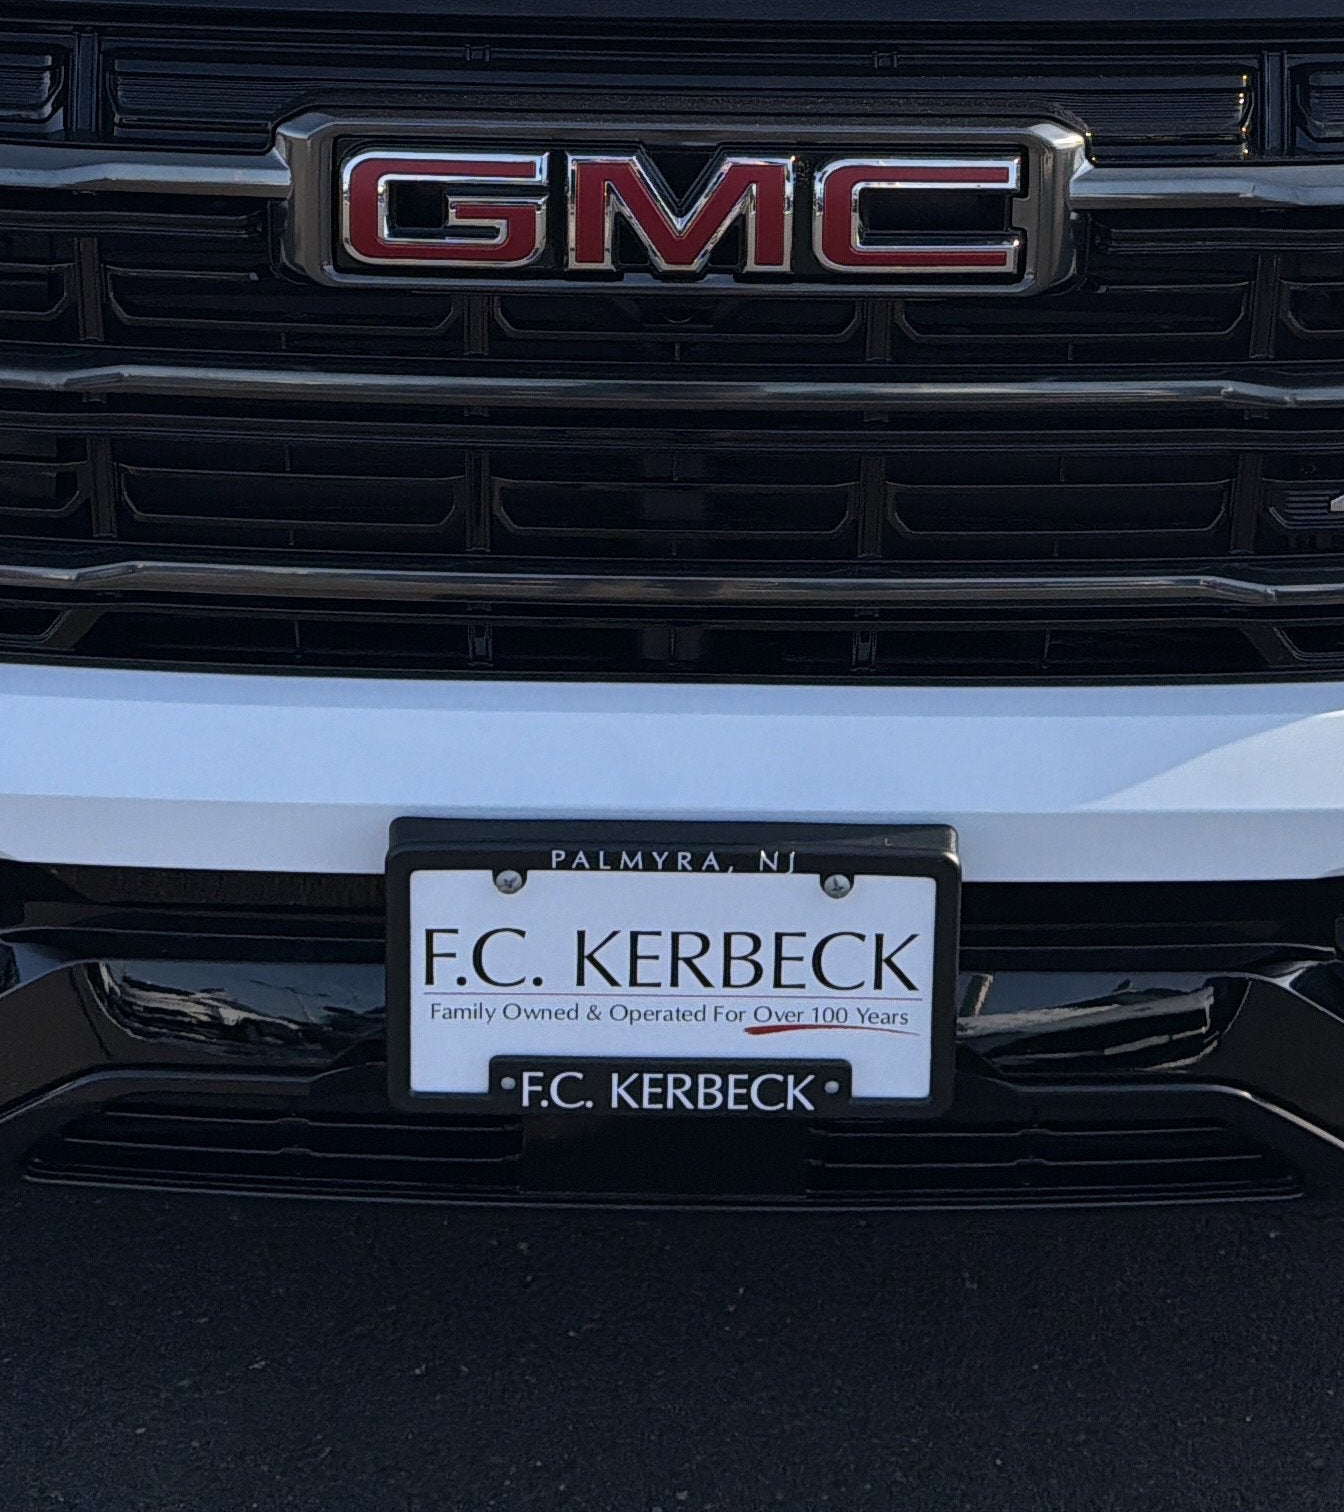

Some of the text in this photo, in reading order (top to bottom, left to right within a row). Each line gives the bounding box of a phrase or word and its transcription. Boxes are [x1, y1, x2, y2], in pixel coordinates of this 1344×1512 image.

[341, 150, 1021, 274] GMC
[550, 849, 796, 875] PALMYRA, NJ
[423, 927, 920, 991] F.C. KERBECK
[430, 1002, 909, 1026] Family Owned & Operated For Over 100 Years
[520, 1070, 816, 1111] F.C. KERBECK
